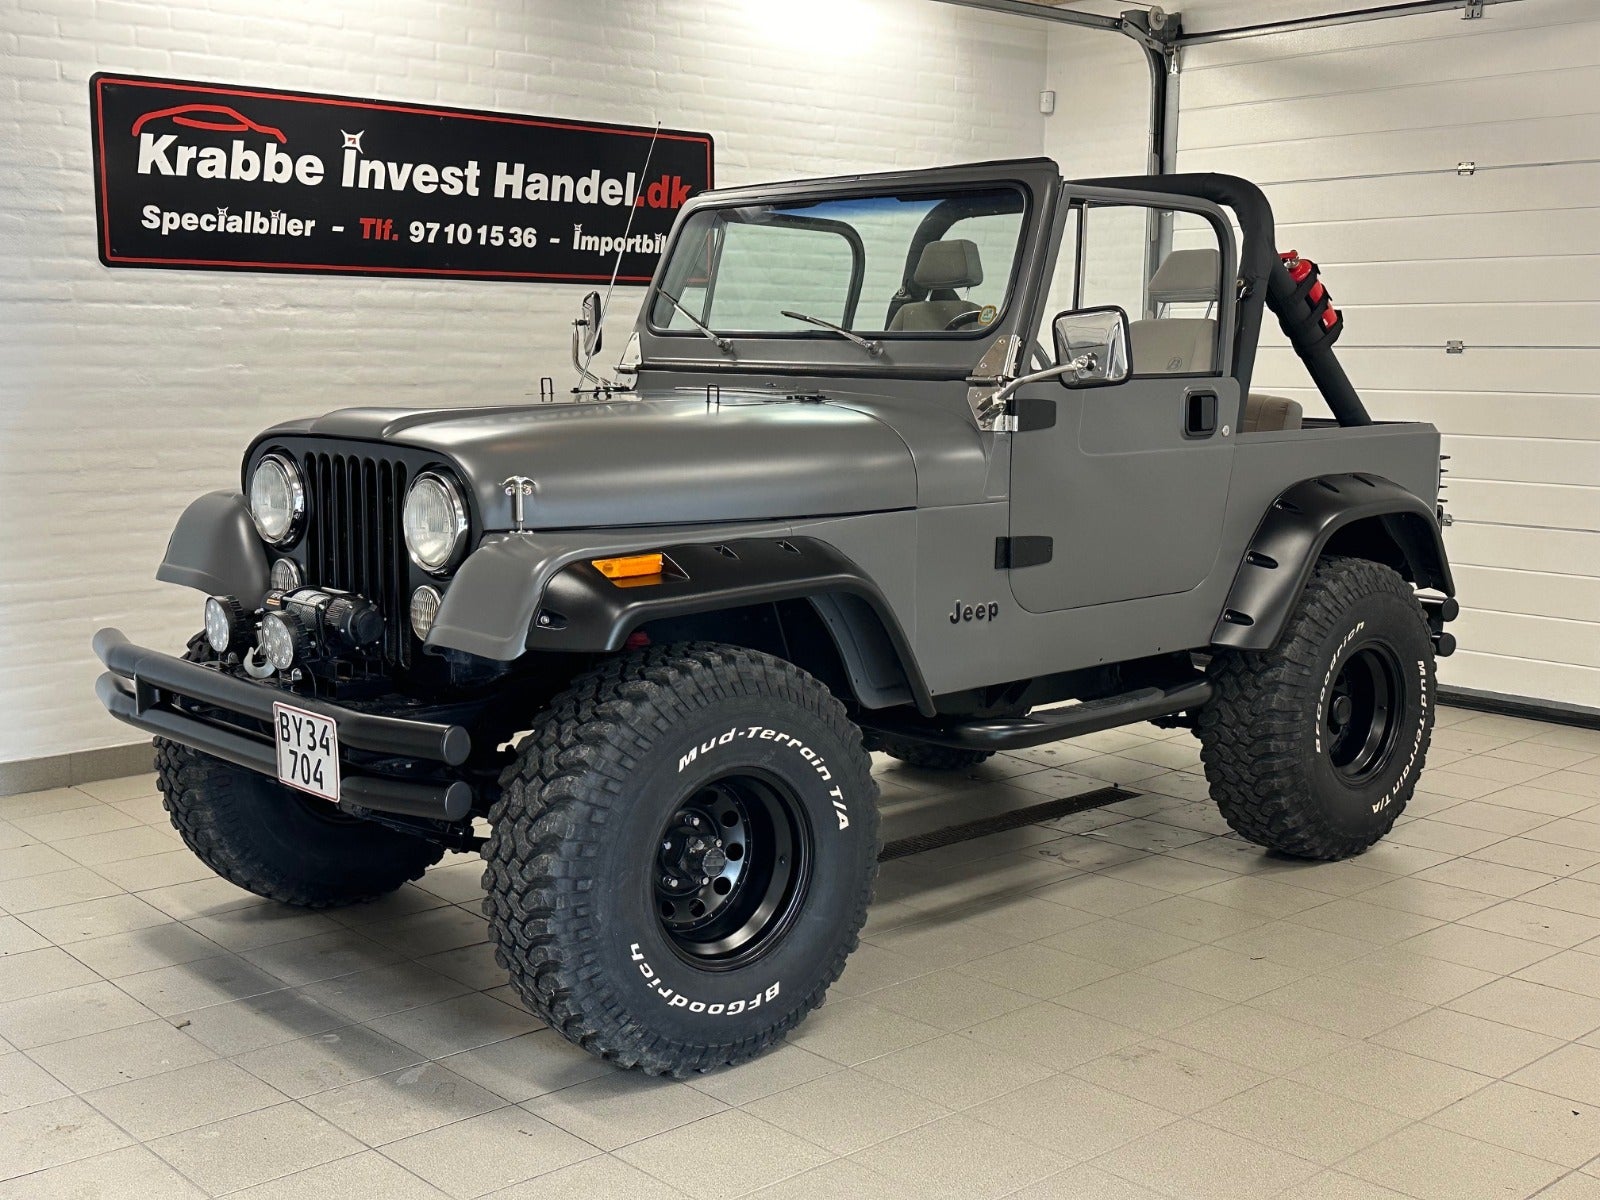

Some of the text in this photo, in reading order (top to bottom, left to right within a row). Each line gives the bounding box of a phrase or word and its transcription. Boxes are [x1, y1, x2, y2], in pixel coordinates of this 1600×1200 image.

[137, 129, 692, 209] Krabbe Invest Handel.dk
[141, 205, 316, 237] Specialbiler
[359, 217, 399, 241] Tlf.
[949, 599, 999, 624] Jeep
[1315, 620, 1365, 753] BFGoodrich
[280, 711, 330, 756] BY34
[289, 748, 323, 790] 704
[1371, 660, 1426, 814] Mud-Terrain T/A
[677, 726, 850, 831] Mud-Terrain T/A
[630, 942, 781, 1016] BFGoodrich
